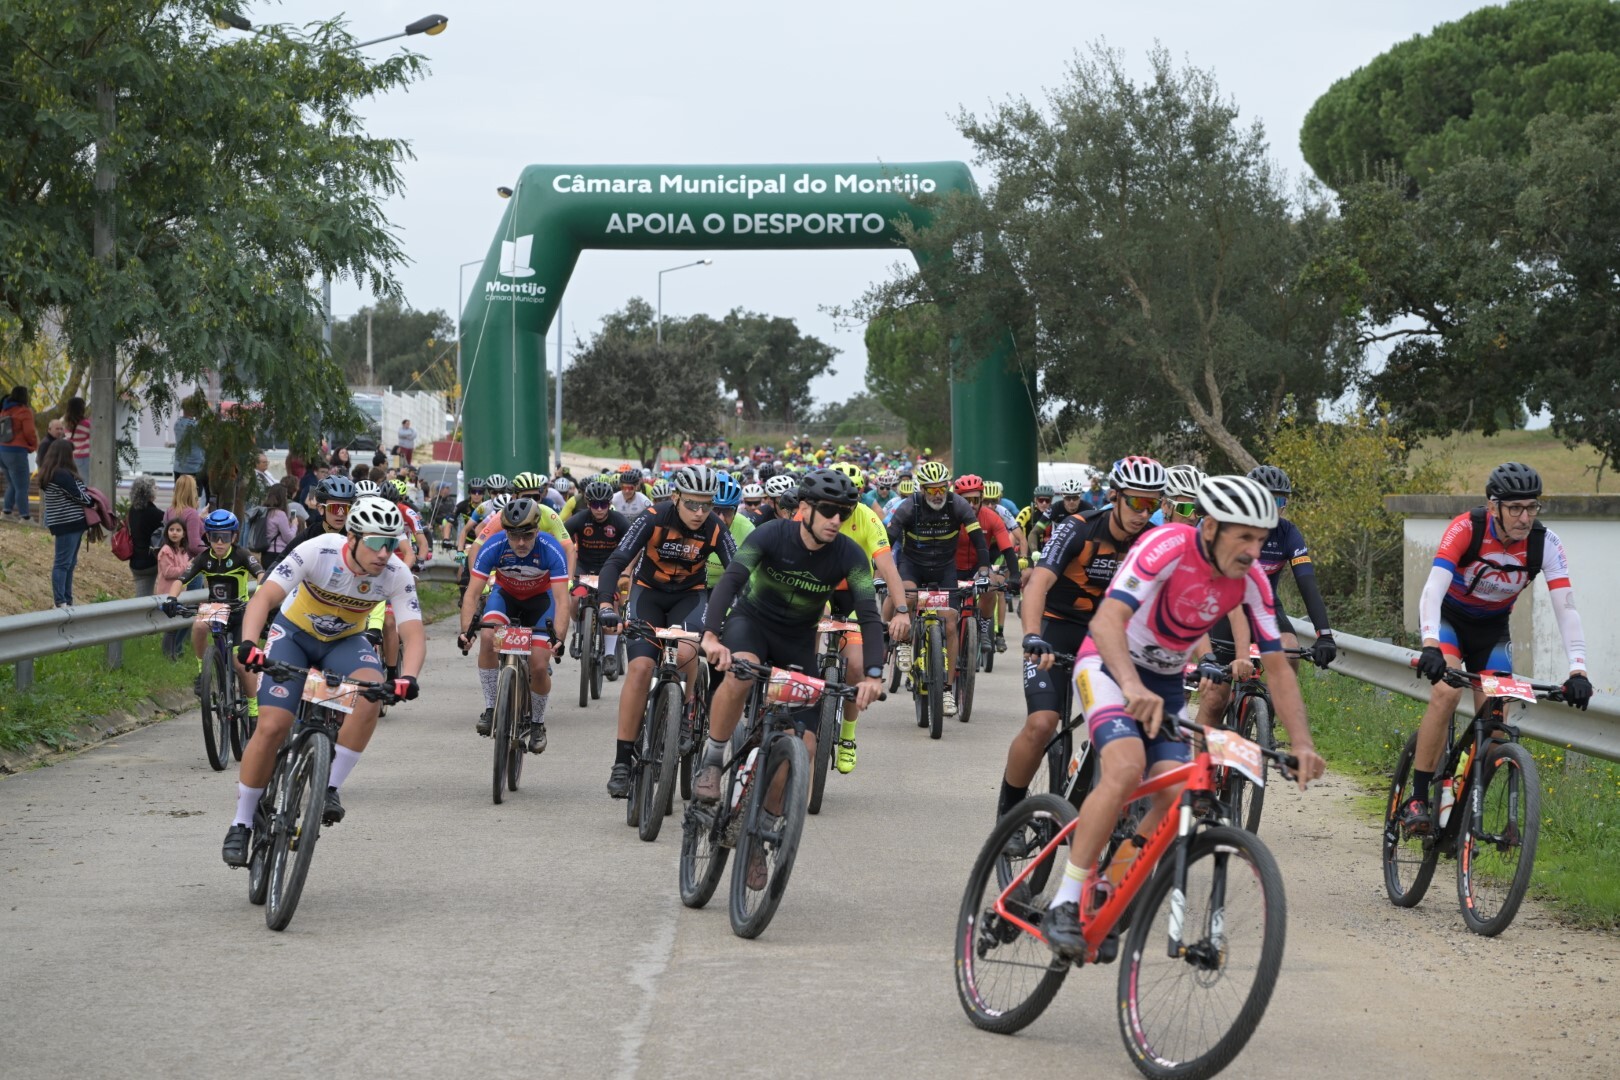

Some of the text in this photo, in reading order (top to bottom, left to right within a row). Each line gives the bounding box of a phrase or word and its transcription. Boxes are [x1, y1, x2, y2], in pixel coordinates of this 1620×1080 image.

[552, 173, 937, 200] Câmara Municipal do Montijo
[604, 212, 885, 234] APOIA O DESPORTO
[485, 281, 547, 296] Montijo
[662, 541, 701, 555] escala
